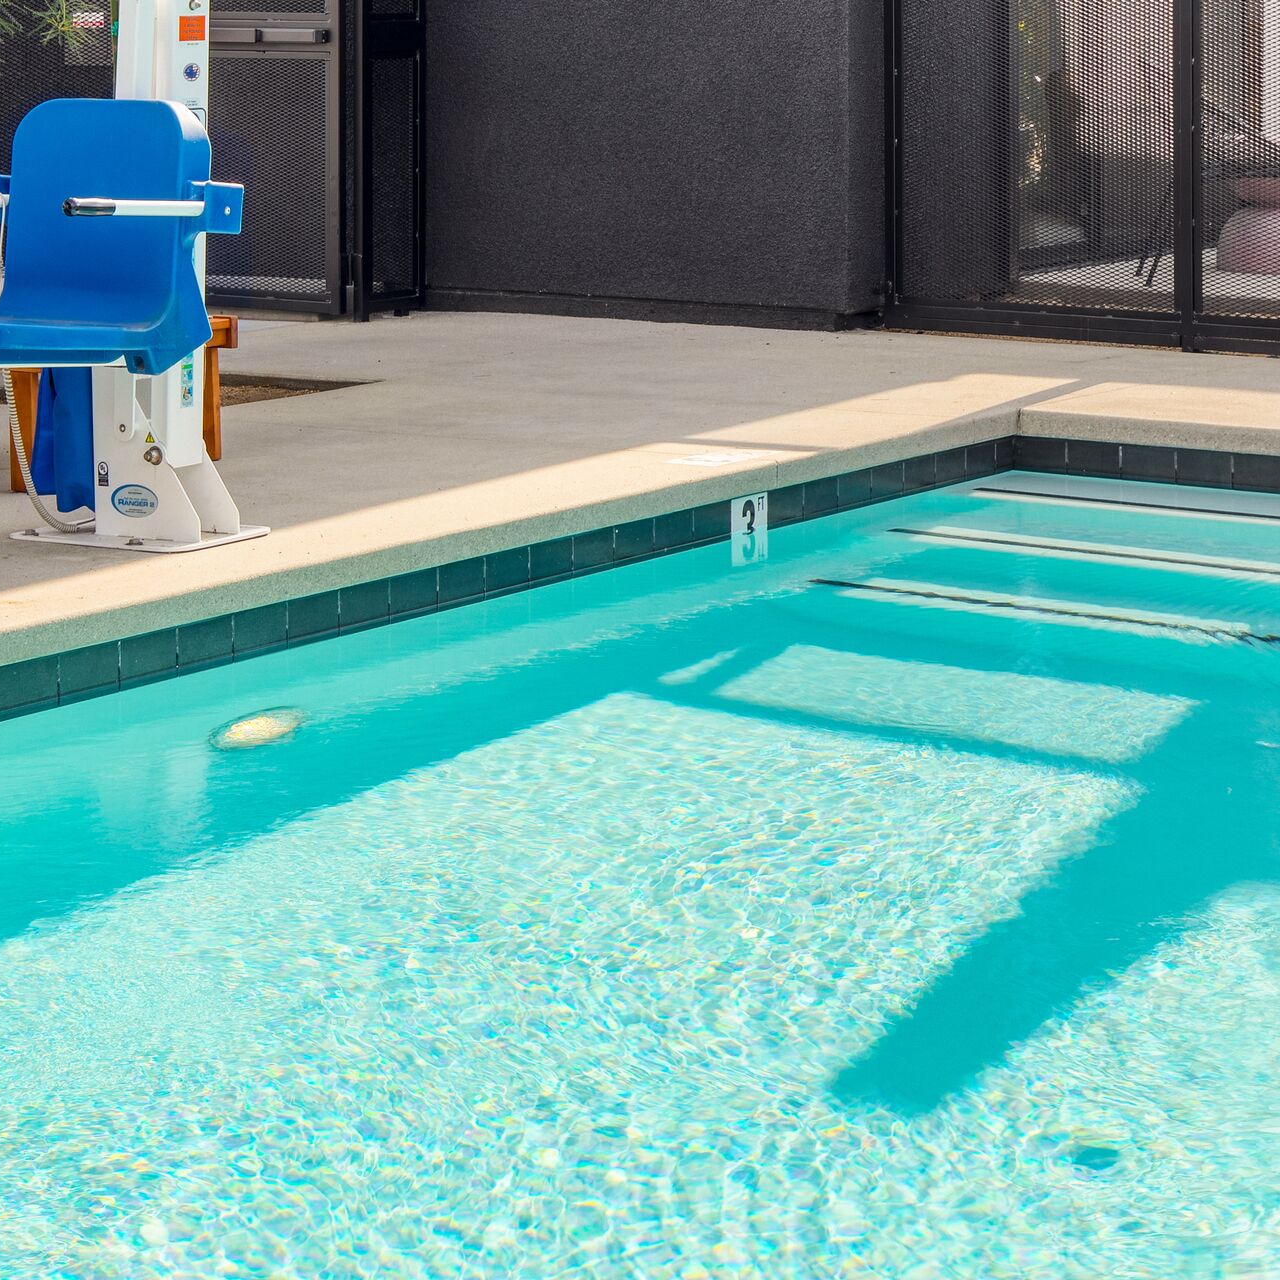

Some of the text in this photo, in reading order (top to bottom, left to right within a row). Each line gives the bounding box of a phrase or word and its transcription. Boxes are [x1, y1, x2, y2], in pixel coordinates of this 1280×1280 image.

[118, 498, 148, 507] RANGER
[741, 496, 765, 536] 3 FT
